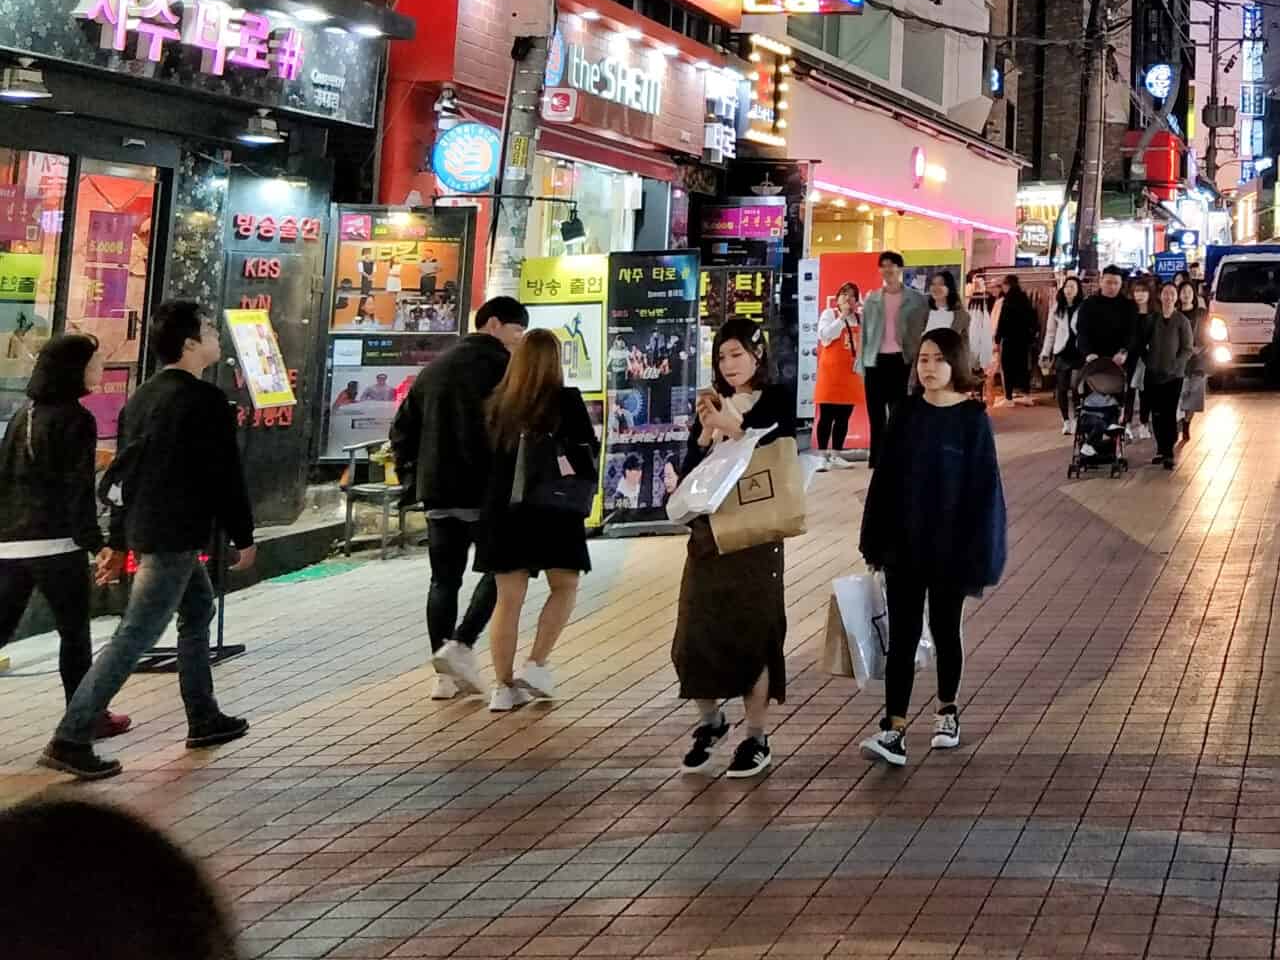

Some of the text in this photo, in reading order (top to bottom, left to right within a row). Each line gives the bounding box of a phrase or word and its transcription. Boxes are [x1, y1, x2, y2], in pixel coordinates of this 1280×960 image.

[244, 257, 281, 279] KBS
[618, 267, 644, 283] 사주
[652, 266, 677, 282] 타로
[526, 277, 603, 298] 방송 출연
